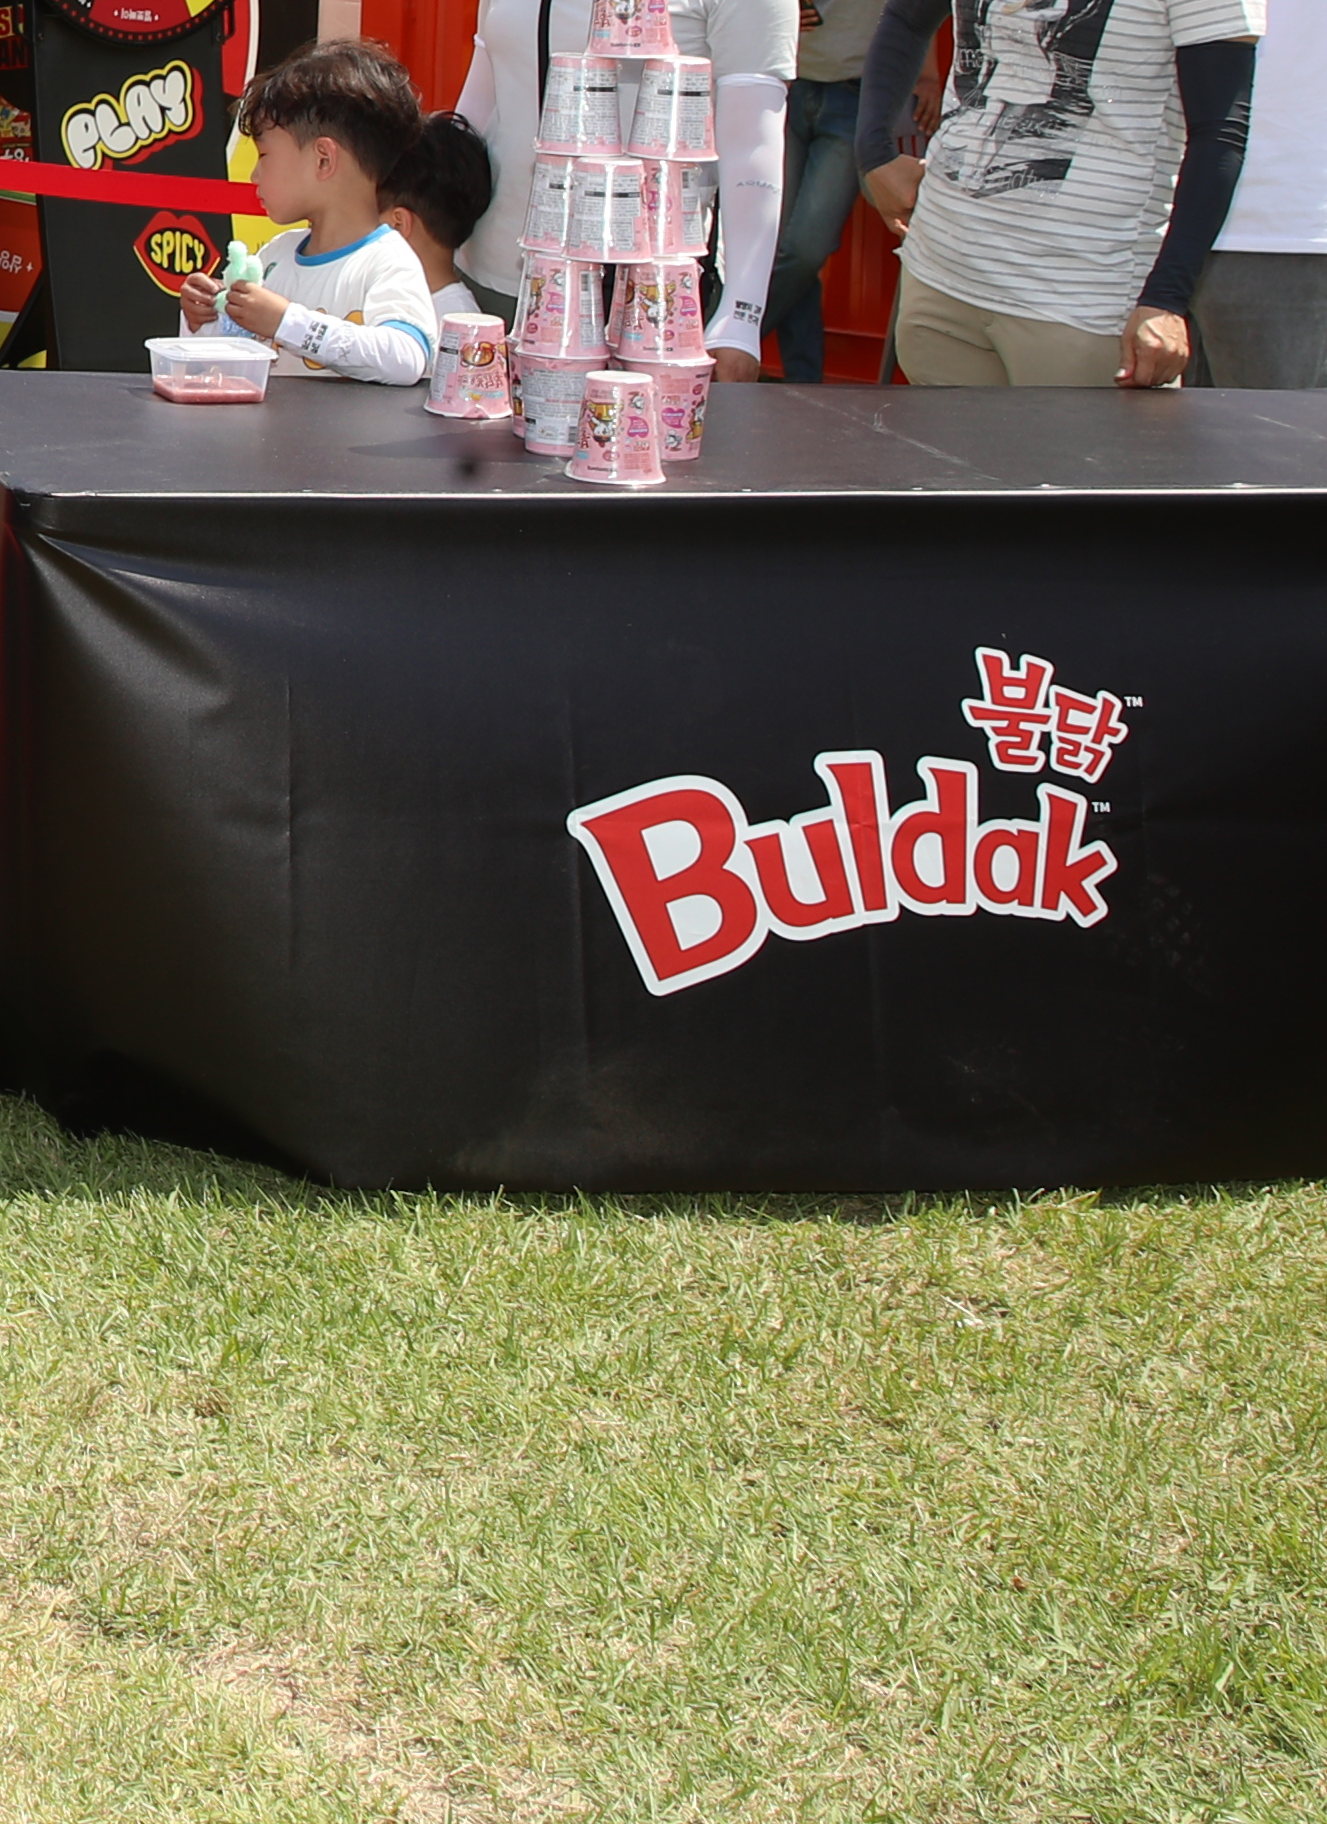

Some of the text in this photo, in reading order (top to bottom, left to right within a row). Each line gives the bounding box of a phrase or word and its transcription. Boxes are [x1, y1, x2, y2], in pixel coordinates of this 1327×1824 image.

[65, 65, 190, 170] PLAY
[150, 229, 206, 274] SPICY
[965, 648, 1127, 782] 불닭
[569, 752, 1117, 996] Buldak
